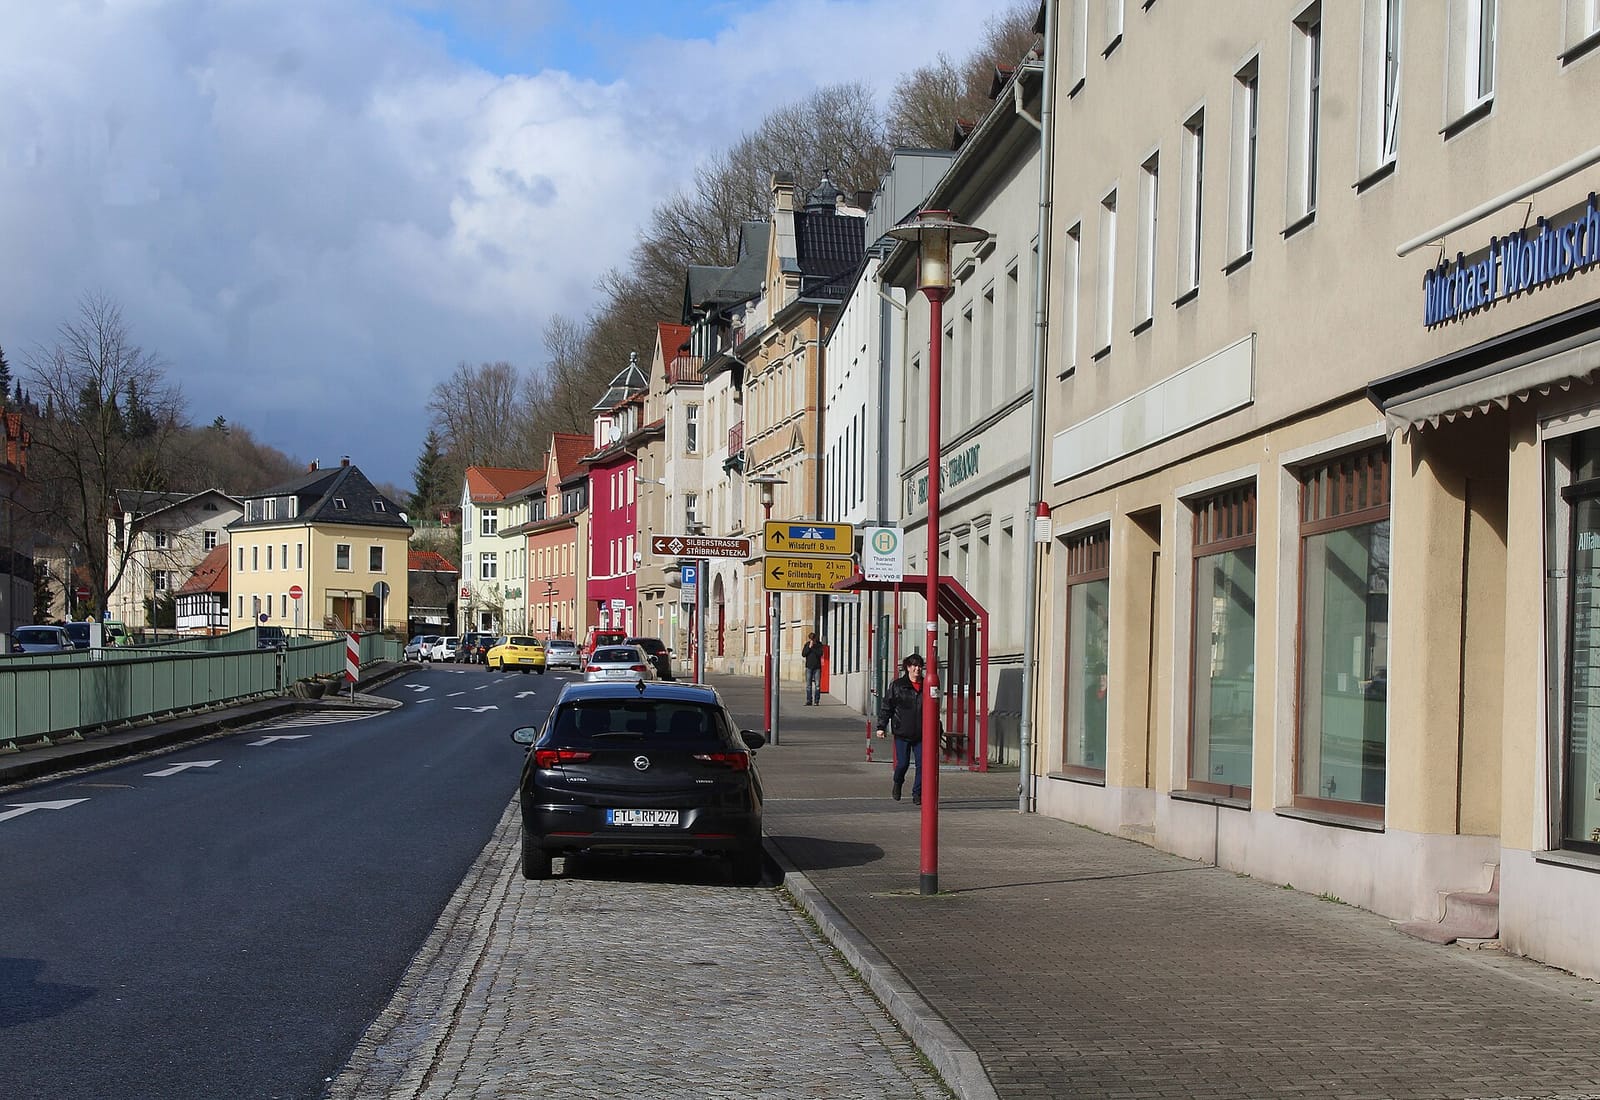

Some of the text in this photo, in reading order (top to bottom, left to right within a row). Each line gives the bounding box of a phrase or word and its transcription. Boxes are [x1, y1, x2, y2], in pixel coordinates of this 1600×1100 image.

[1423, 235, 1497, 327] Michael
[686, 538, 740, 548] SILBERSTRASSE
[788, 541, 816, 550] Wilsdruff
[819, 542, 825, 550] 8
[879, 534, 890, 549] H
[721, 548, 747, 557] STEZKA
[787, 559, 813, 570] Freiberg
[826, 561, 834, 570] 21
[685, 568, 695, 582] P
[787, 570, 822, 580] Grillenburg
[829, 571, 835, 579] 7
[787, 580, 806, 589] Kurort
[806, 581, 826, 589] Hartha
[614, 810, 677, 823] FTL RM 277
